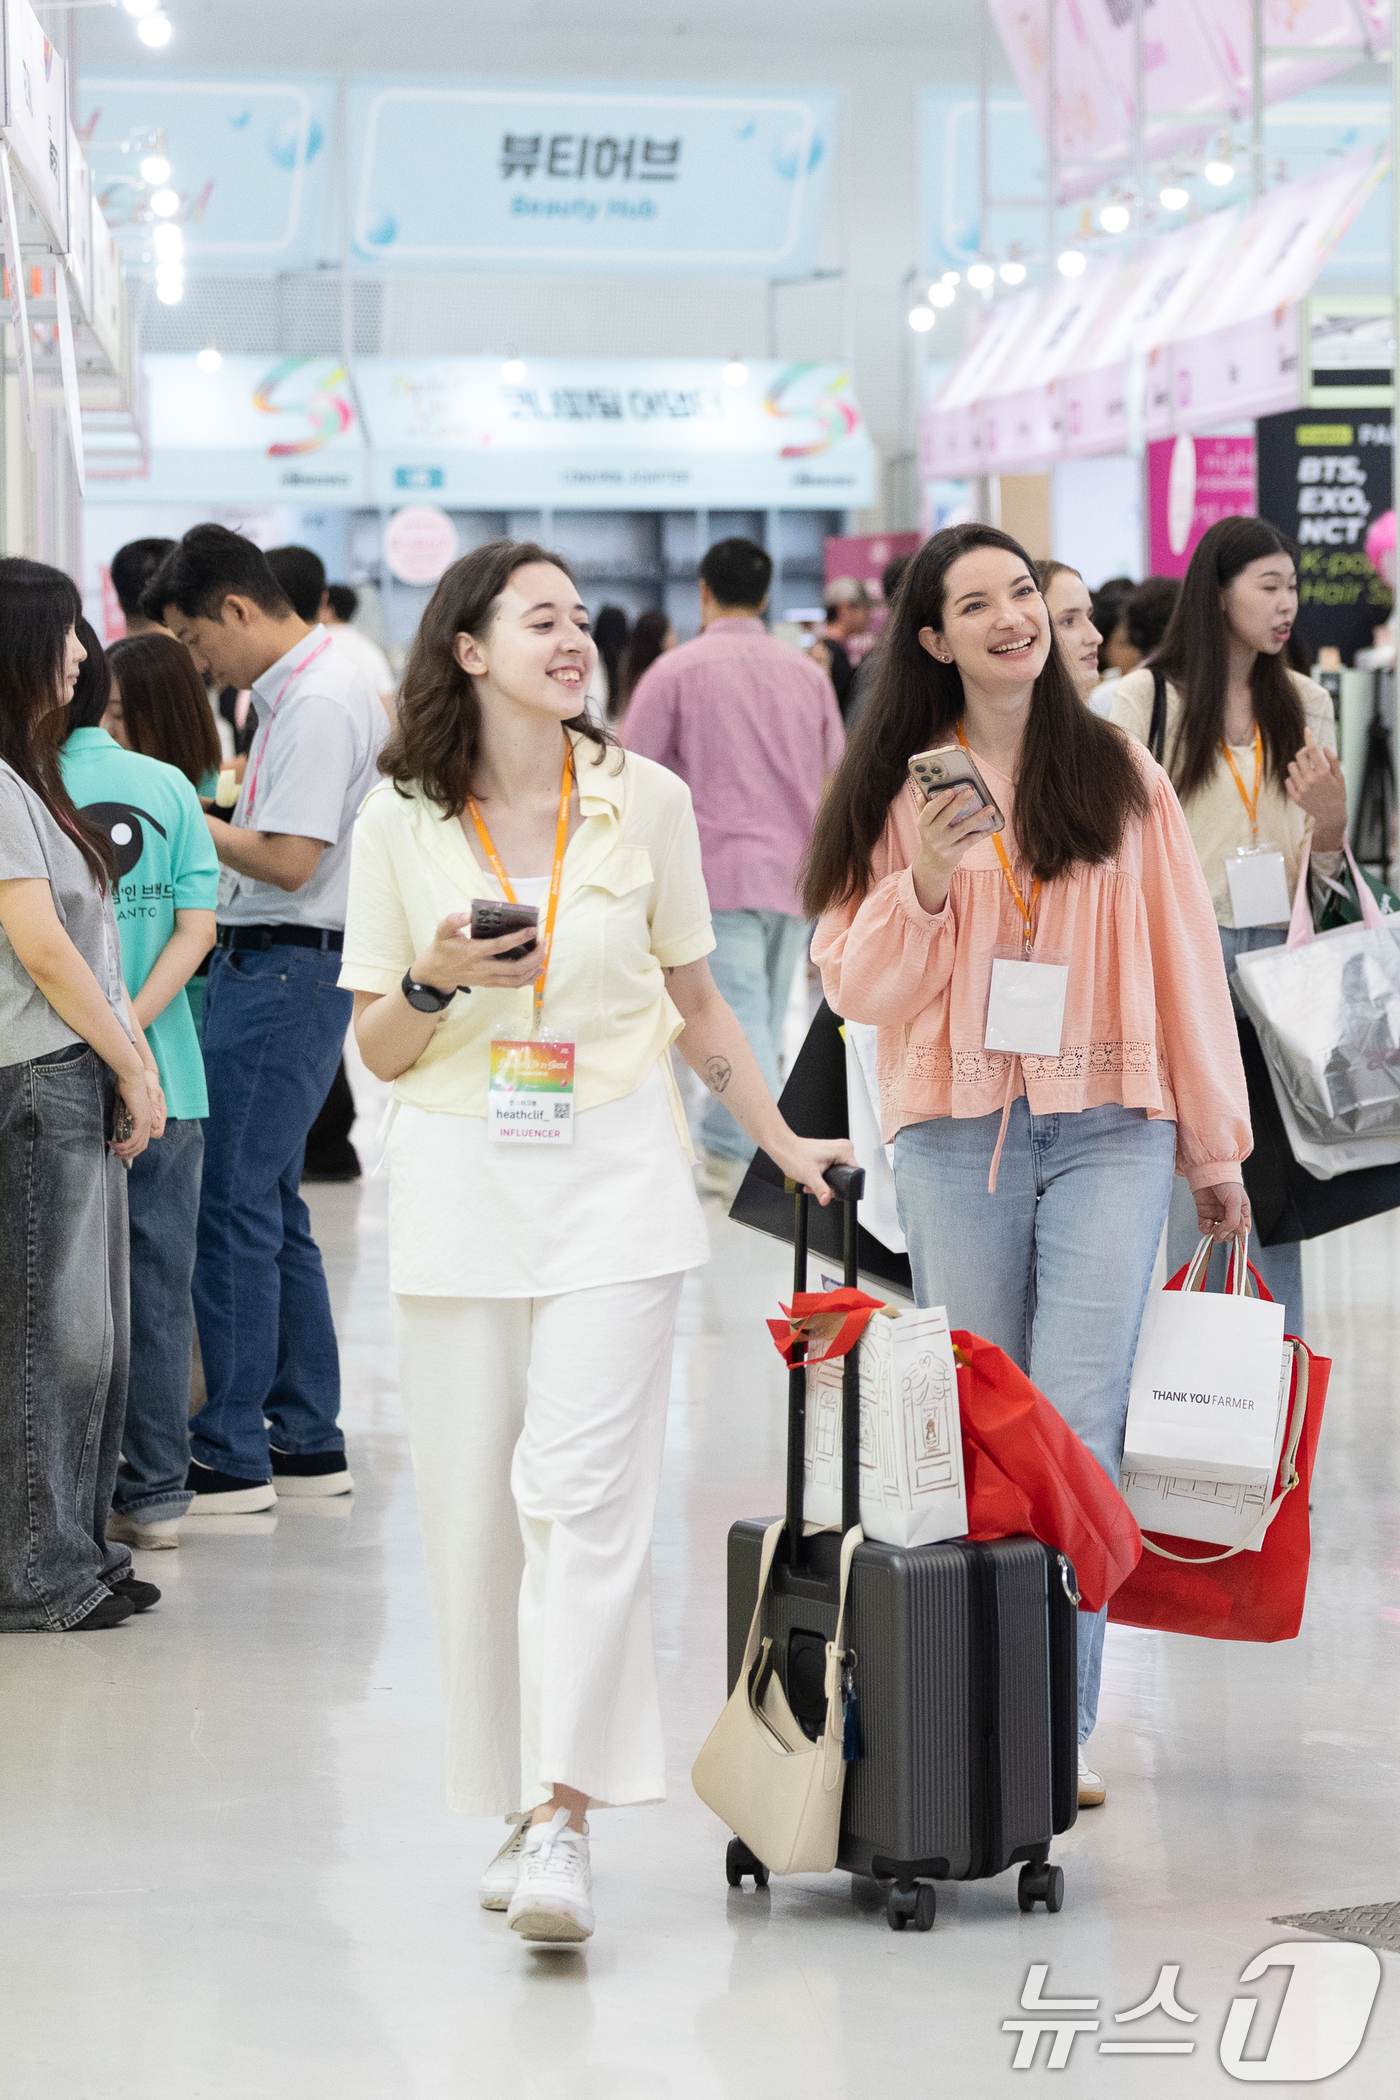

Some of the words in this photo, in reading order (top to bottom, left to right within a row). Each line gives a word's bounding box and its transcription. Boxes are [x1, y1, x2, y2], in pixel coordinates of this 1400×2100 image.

[1297, 455, 1367, 487] BTS,
[1297, 485, 1372, 517] EXO,
[1297, 516, 1366, 545] NCT
[1301, 550, 1376, 578] K-po
[1301, 577, 1363, 606] Hair
[141, 882, 175, 900] 브랜드
[496, 1109, 550, 1122] heathclif_
[500, 1128, 561, 1138] INFLUENCER
[1152, 1390, 1188, 1402] THANK
[1189, 1393, 1211, 1404] YOU
[1212, 1395, 1255, 1411] FARMER
